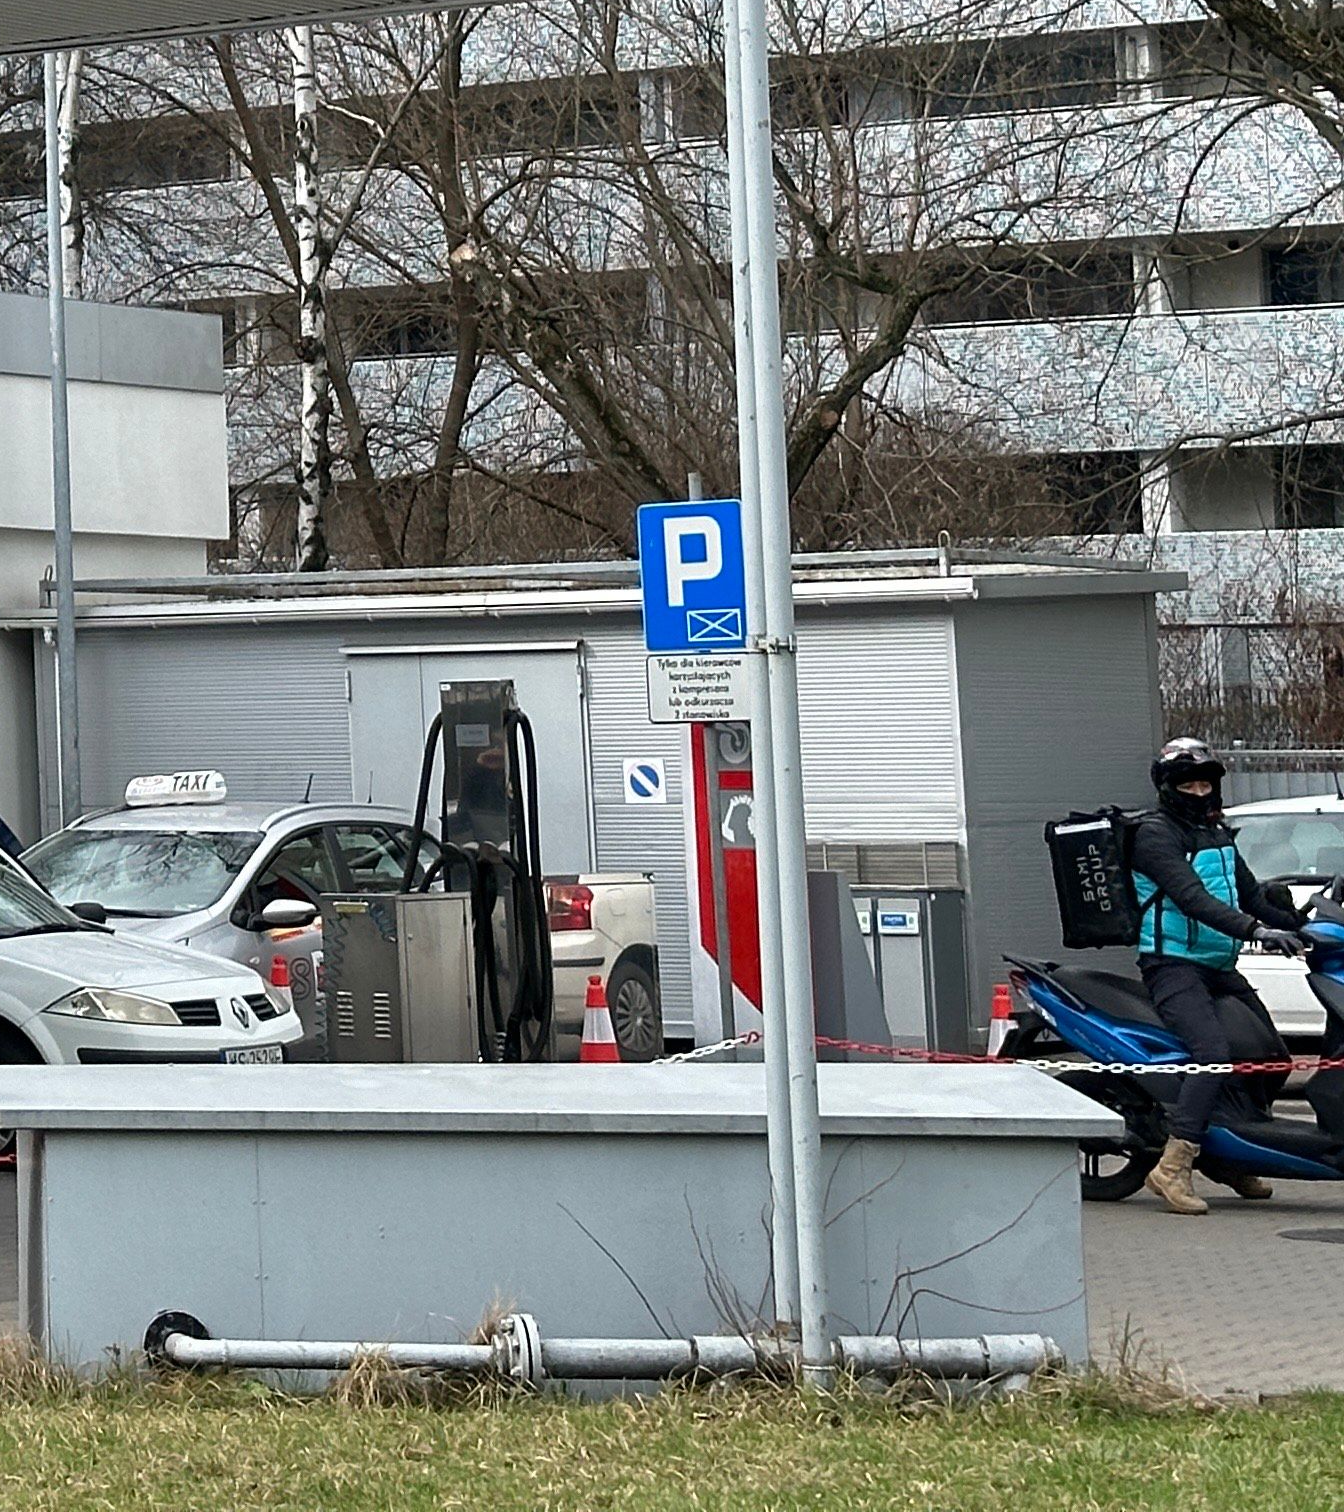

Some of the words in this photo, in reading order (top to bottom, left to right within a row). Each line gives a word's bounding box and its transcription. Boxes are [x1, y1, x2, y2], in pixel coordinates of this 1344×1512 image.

[663, 515, 723, 607] P
[173, 774, 210, 792] TAXI
[1088, 844, 1112, 912] GROUP
